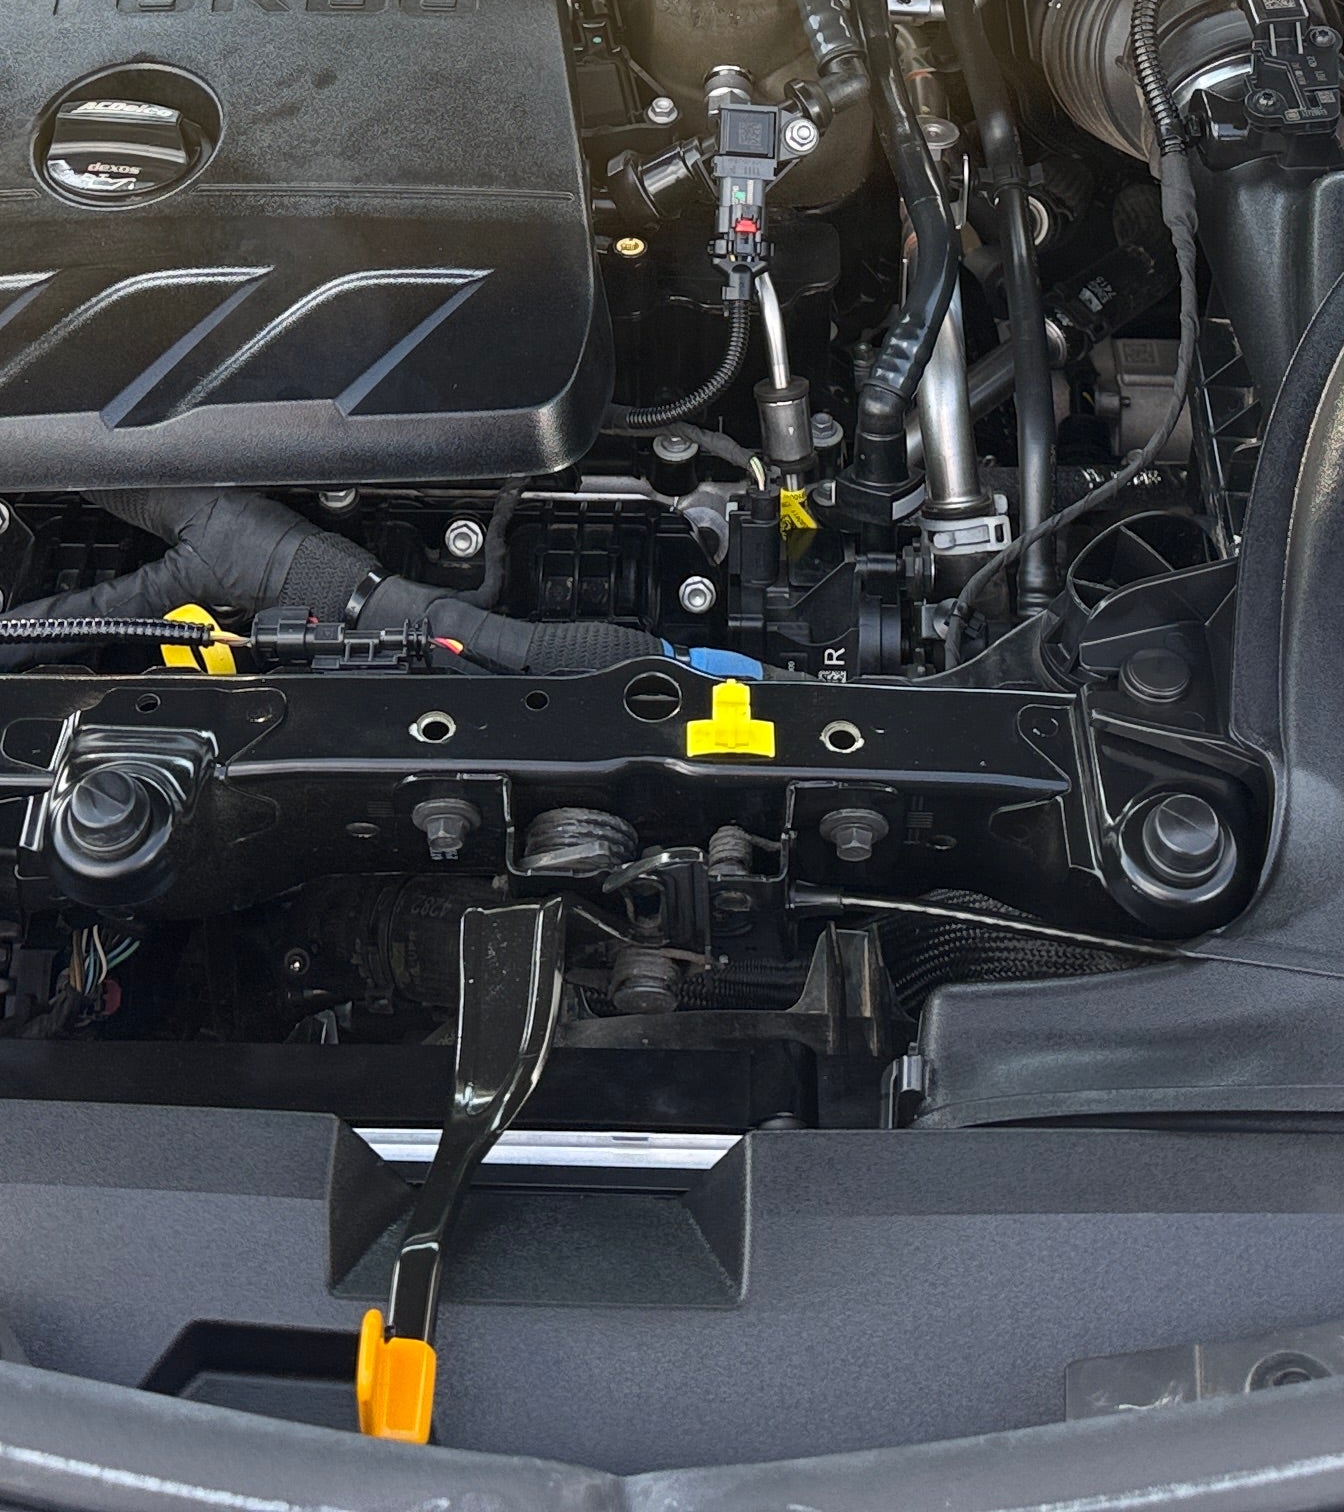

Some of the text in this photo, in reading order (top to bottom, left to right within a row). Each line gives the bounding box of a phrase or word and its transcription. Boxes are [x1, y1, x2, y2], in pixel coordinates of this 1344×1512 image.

[78, 101, 174, 118] ACDelco
[87, 162, 143, 175] dexos
[824, 647, 846, 665] R
